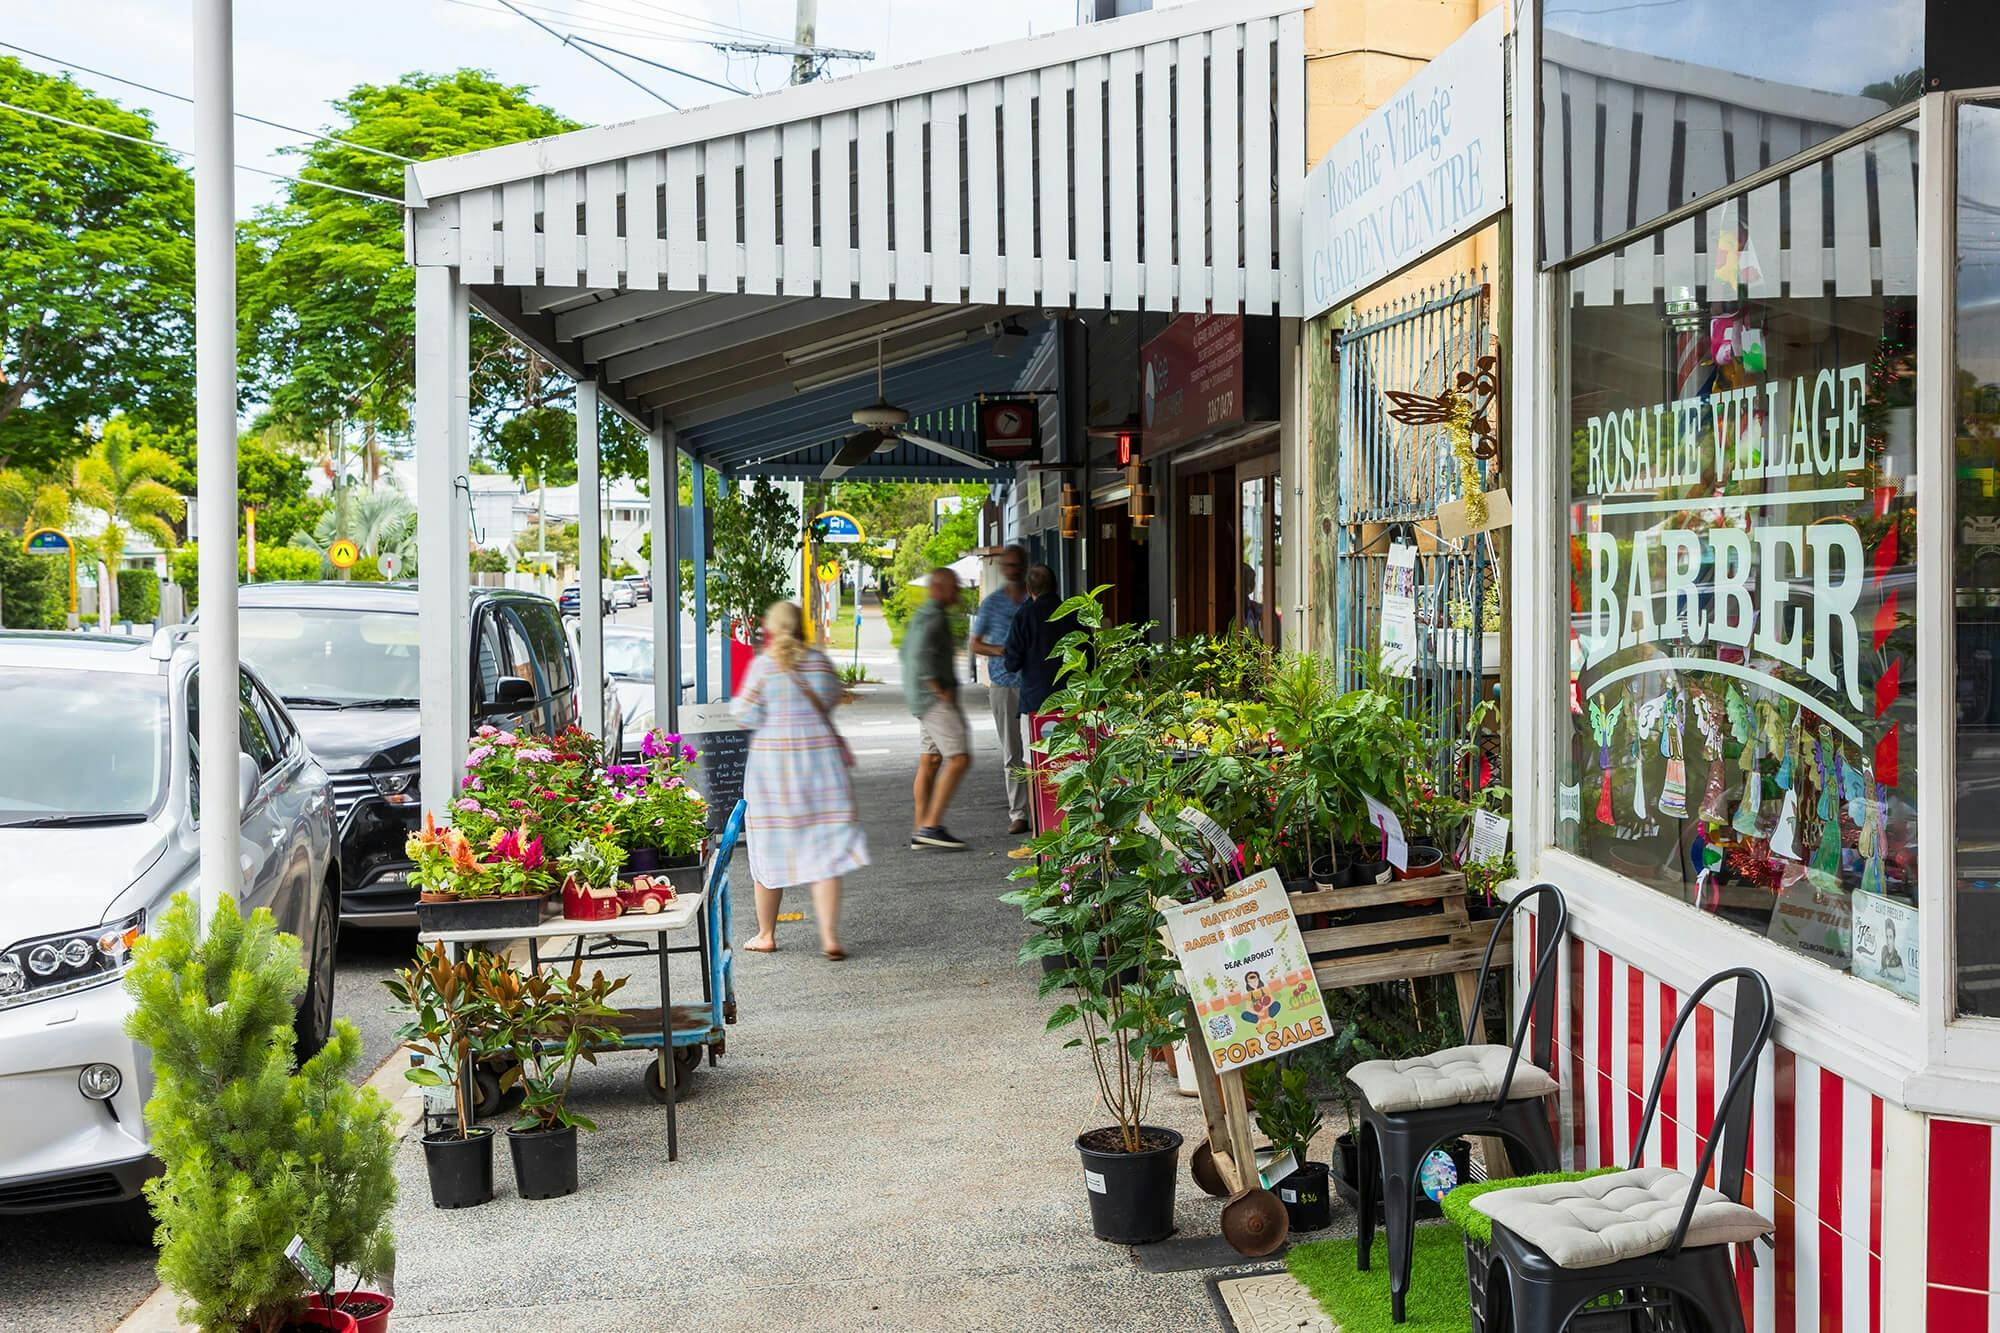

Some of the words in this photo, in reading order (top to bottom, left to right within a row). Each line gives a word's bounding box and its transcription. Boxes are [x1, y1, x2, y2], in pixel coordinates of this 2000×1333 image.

[1327, 127, 1382, 219] Rosalie
[1384, 86, 1452, 169] Village
[1313, 205, 1387, 304] GARDEN
[1390, 138, 1484, 258] CENTRE
[1586, 397, 1702, 496] ROSALIE
[1710, 363, 1867, 482] VILLAGE
[1586, 523, 1864, 713] BARBER
[1200, 899, 1260, 928] NATIVES
[1887, 906, 1904, 921] PRESLEY
[1183, 932, 1218, 953] RARE
[1224, 960, 1243, 970] DEAR
[1243, 947, 1274, 965] ARBORIST
[1212, 1038, 1264, 1069] FOR
[1265, 1016, 1327, 1052] SALE
